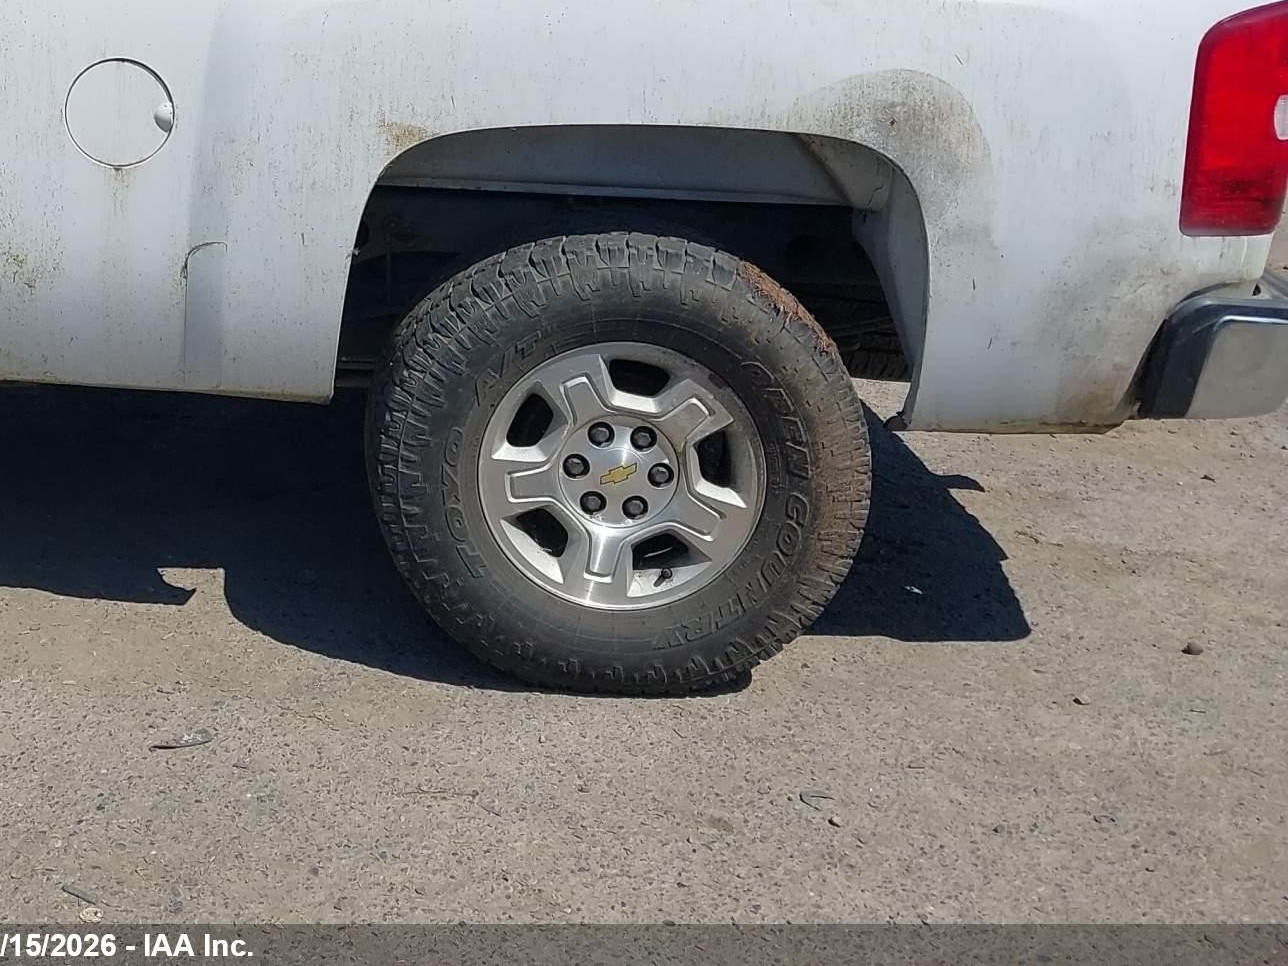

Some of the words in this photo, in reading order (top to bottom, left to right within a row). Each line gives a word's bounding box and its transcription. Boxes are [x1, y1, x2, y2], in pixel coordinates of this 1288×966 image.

[740, 360, 812, 481] OPEN
[441, 426, 488, 579] TOYO
[652, 491, 810, 650] COUNTRY
